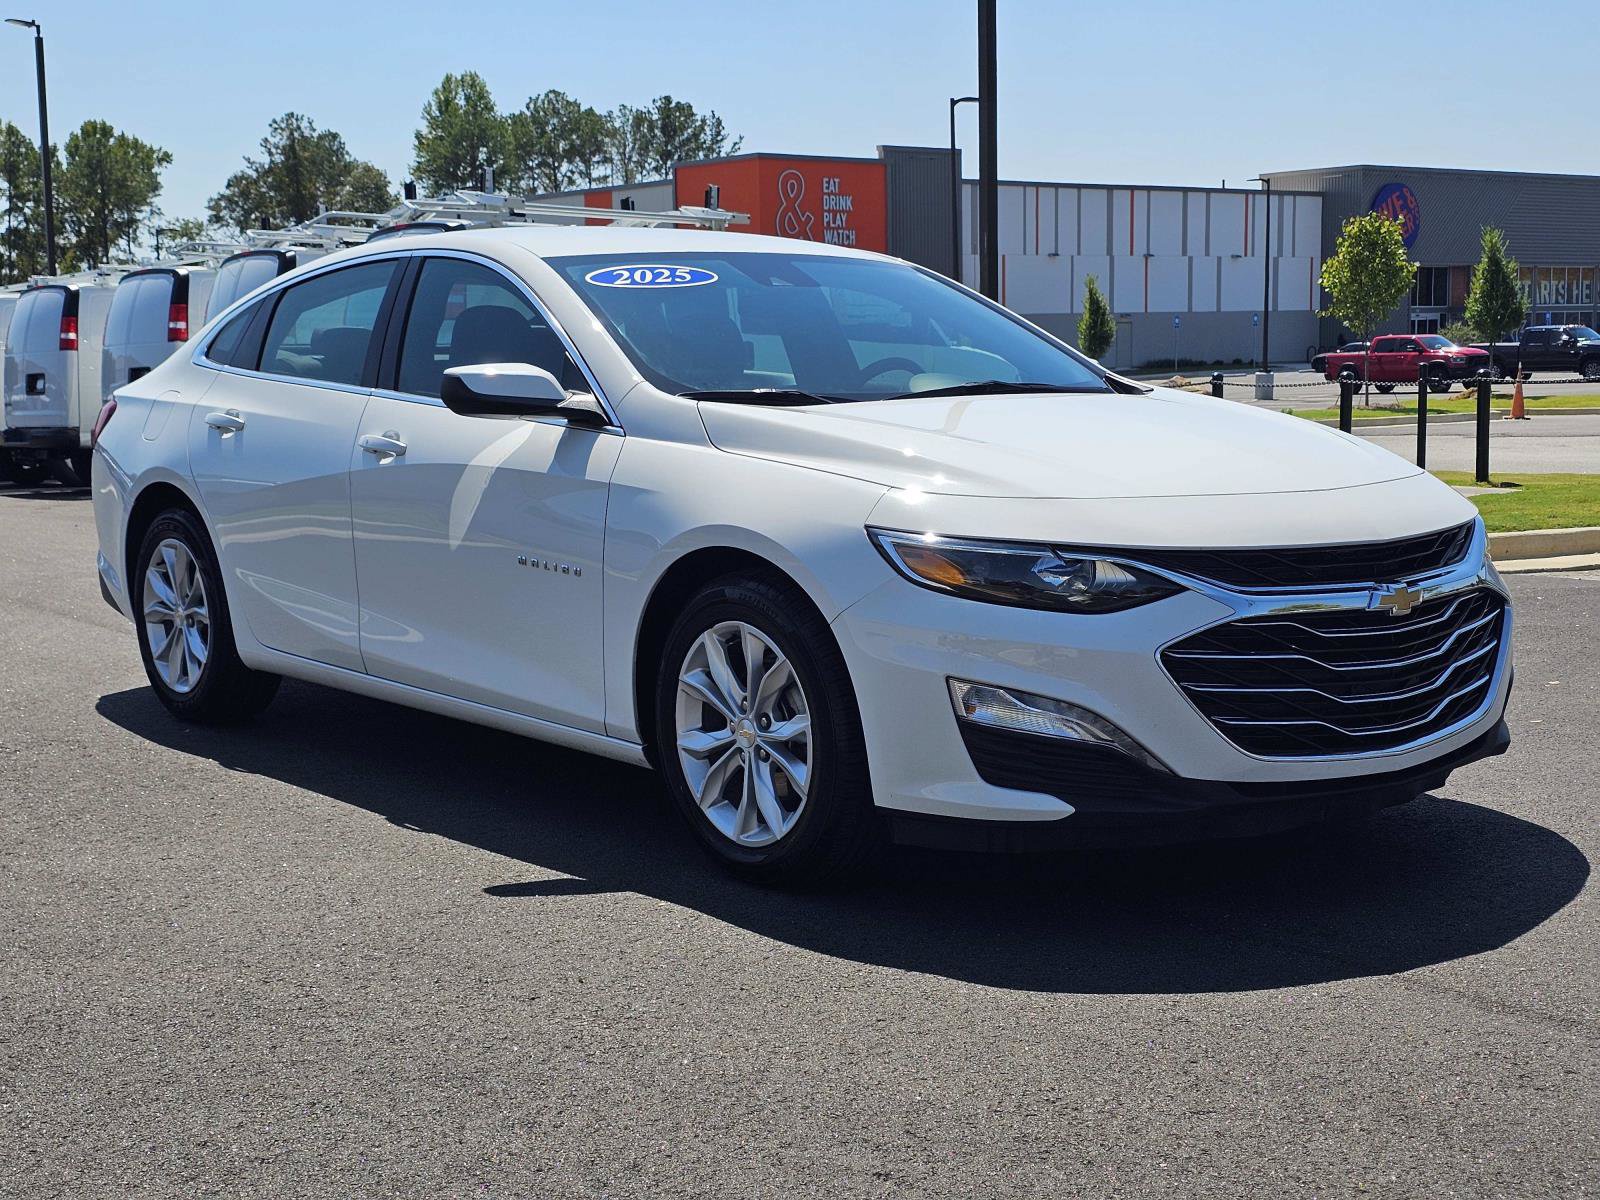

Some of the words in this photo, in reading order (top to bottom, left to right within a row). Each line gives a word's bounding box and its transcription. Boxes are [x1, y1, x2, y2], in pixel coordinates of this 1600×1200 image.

[822, 178, 840, 193] EAT
[823, 195, 853, 211] DRINK
[823, 212, 848, 228] PLAY
[824, 229, 856, 246] WATCH
[612, 268, 692, 286] 2025
[517, 555, 582, 577] MALIBU
